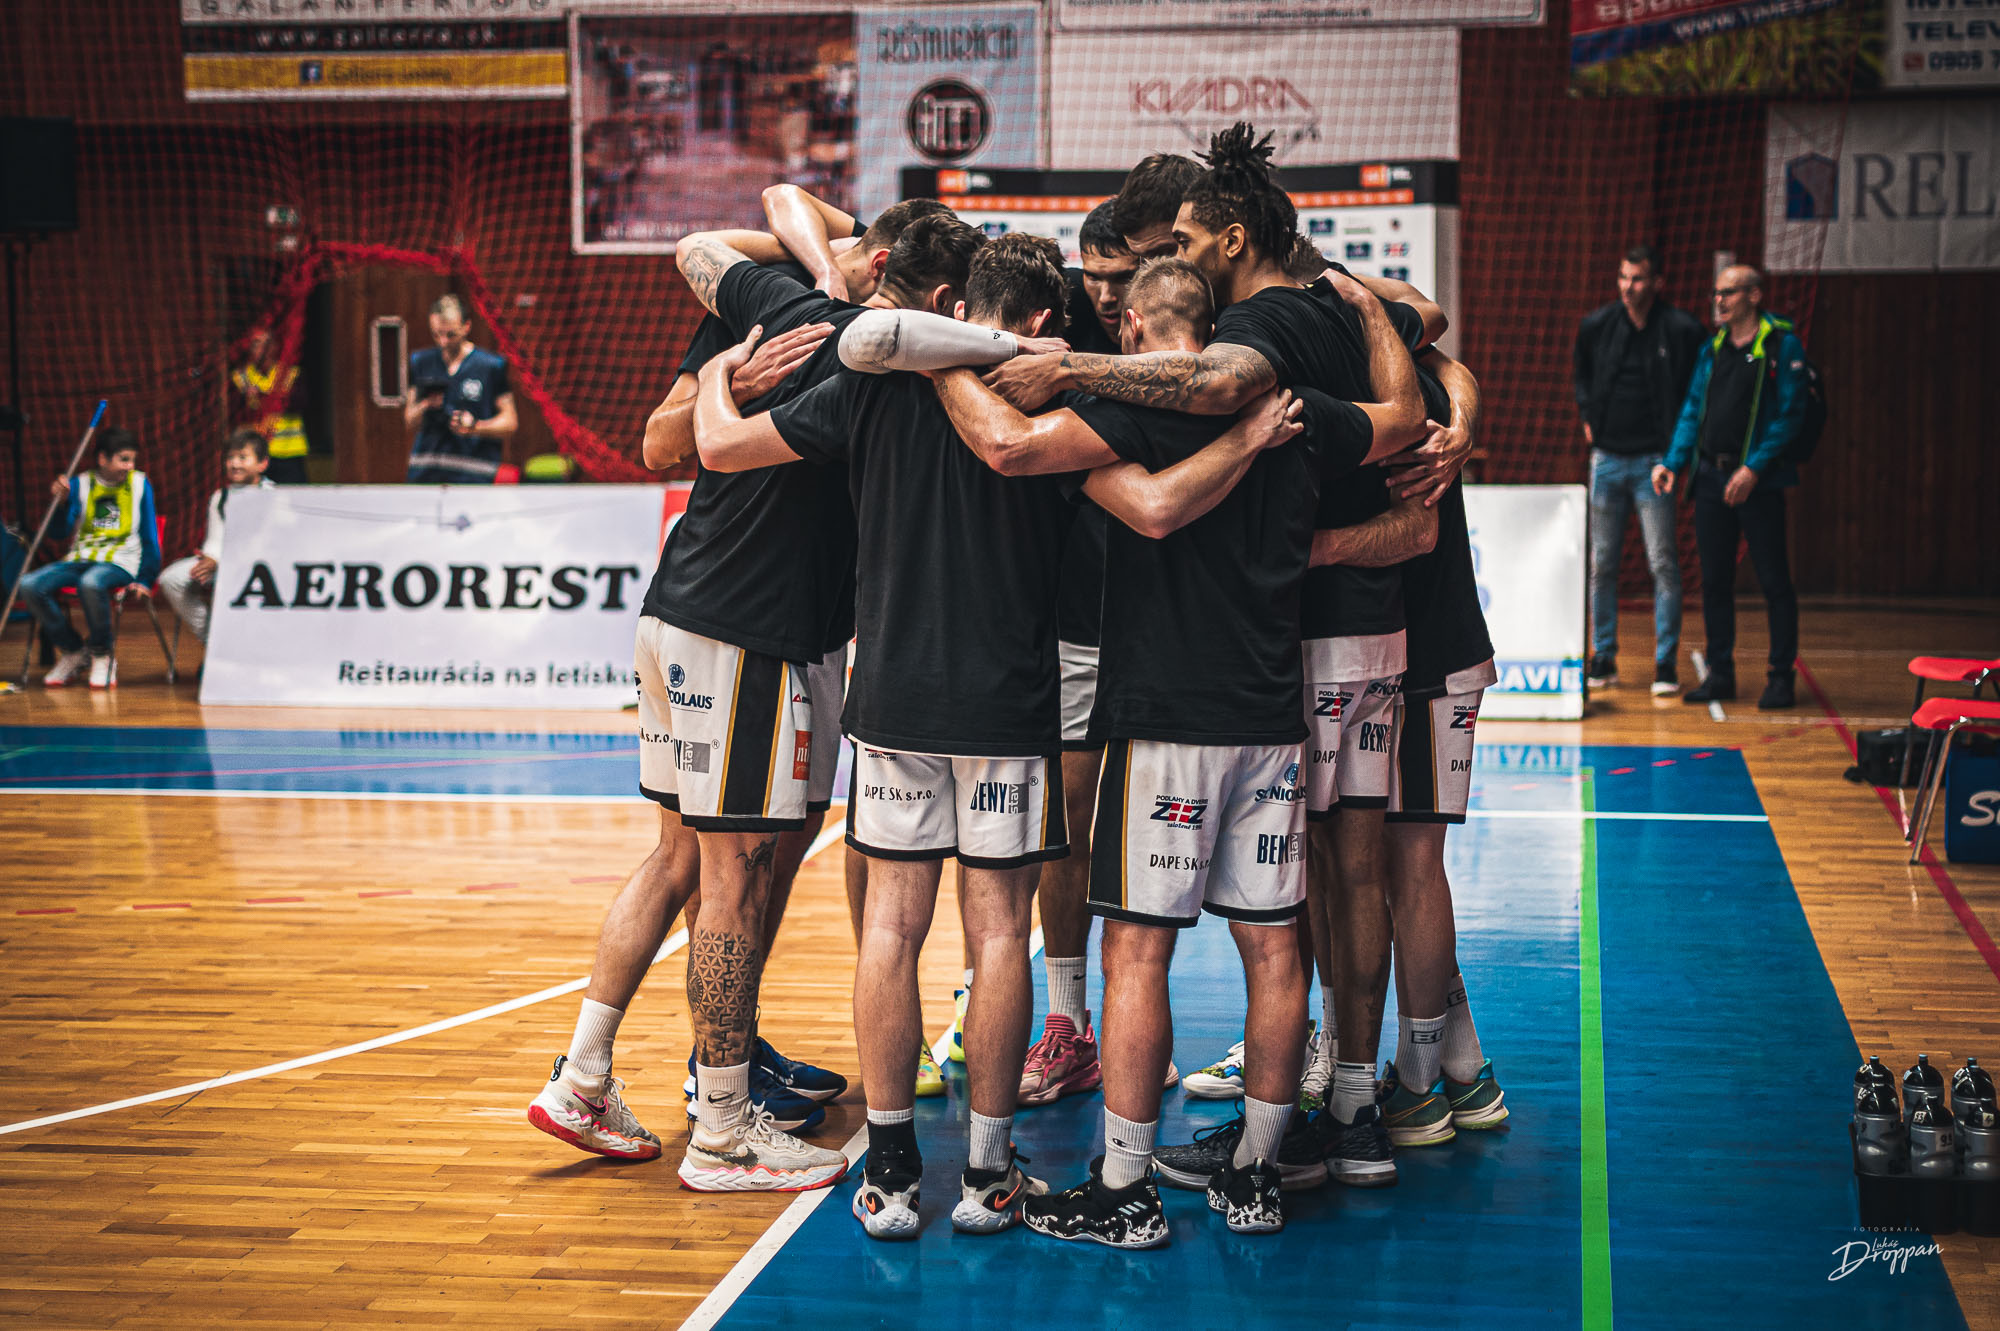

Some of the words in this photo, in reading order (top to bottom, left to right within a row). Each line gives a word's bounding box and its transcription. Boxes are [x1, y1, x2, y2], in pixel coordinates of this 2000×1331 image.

[230, 560, 640, 610] AEROREST
[338, 660, 496, 686] Reštaurácia
[505, 666, 537, 685] na
[888, 787, 903, 801] SK
[905, 789, 936, 801] s.r.o.
[1150, 853, 1181, 870] DAPE
[1183, 856, 1199, 871] SK
